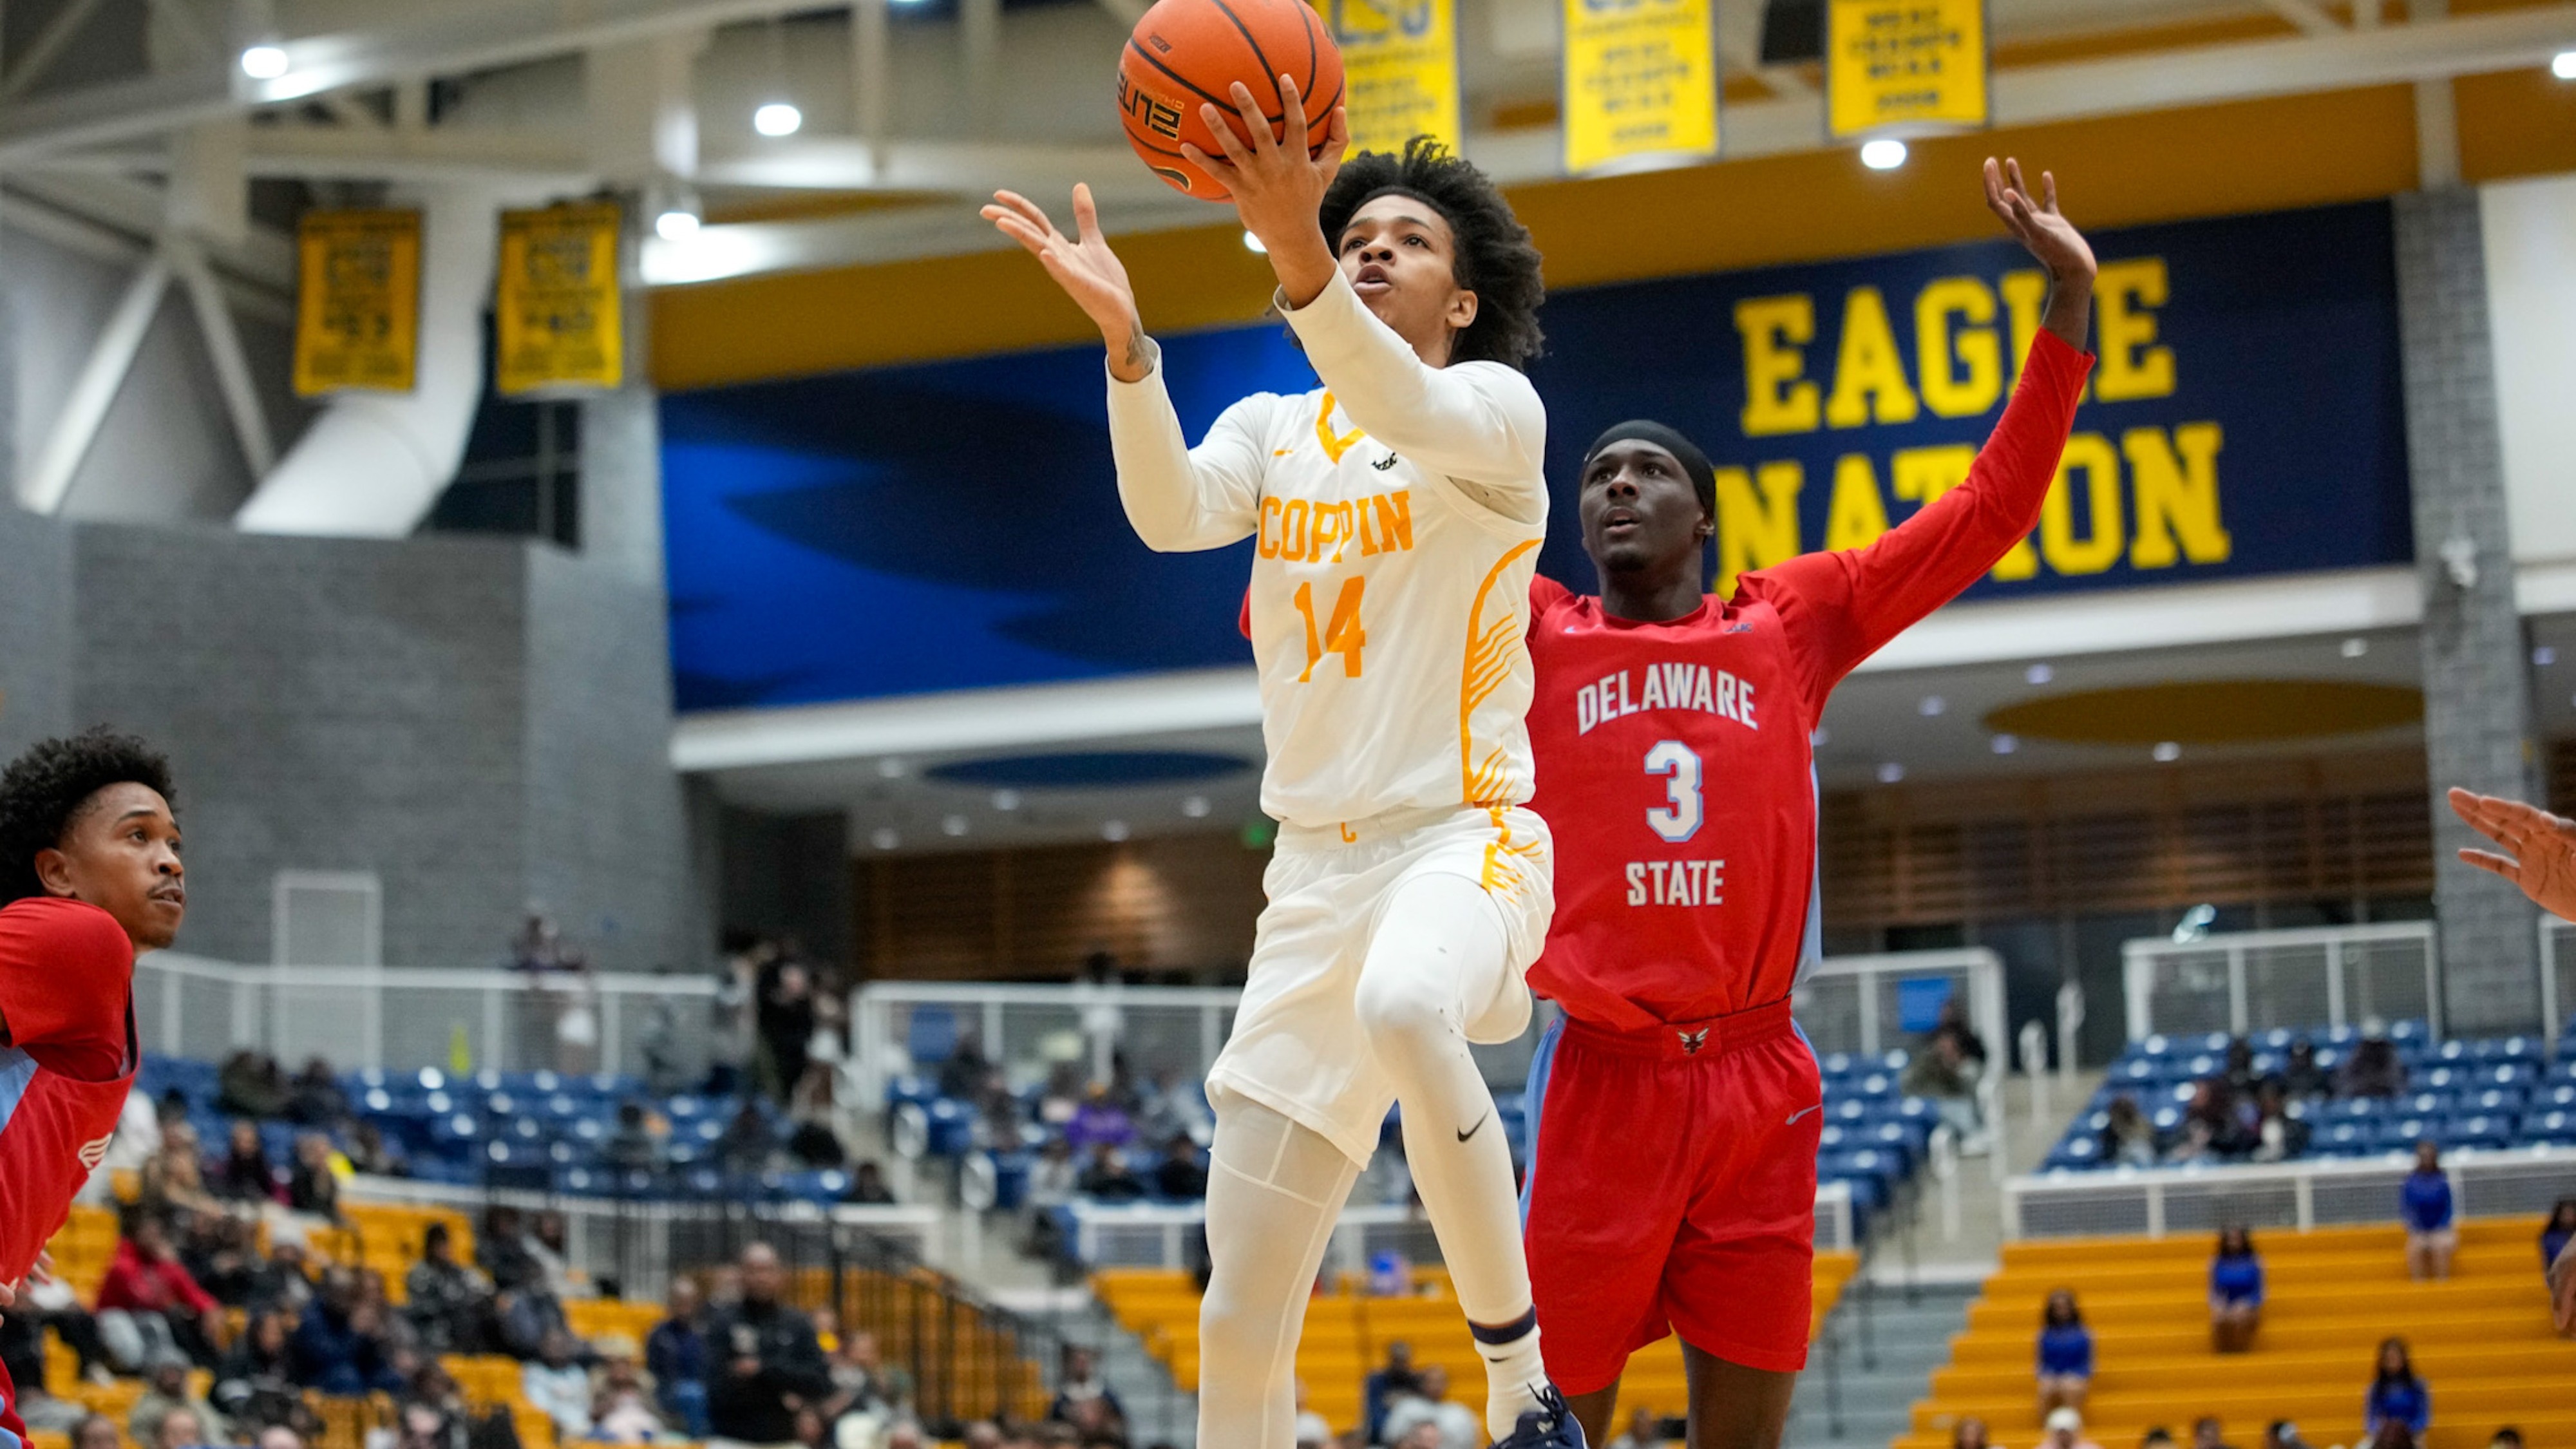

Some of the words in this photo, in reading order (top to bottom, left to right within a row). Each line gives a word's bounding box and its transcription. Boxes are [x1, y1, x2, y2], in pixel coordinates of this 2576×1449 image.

[1258, 490, 1414, 564] COPPIN
[1713, 421, 2230, 601] NATON
[1293, 575, 1366, 683] 14
[1577, 661, 1759, 737] DELAWARE
[1643, 739, 1703, 843] 3
[1625, 859, 1725, 907] STATE
